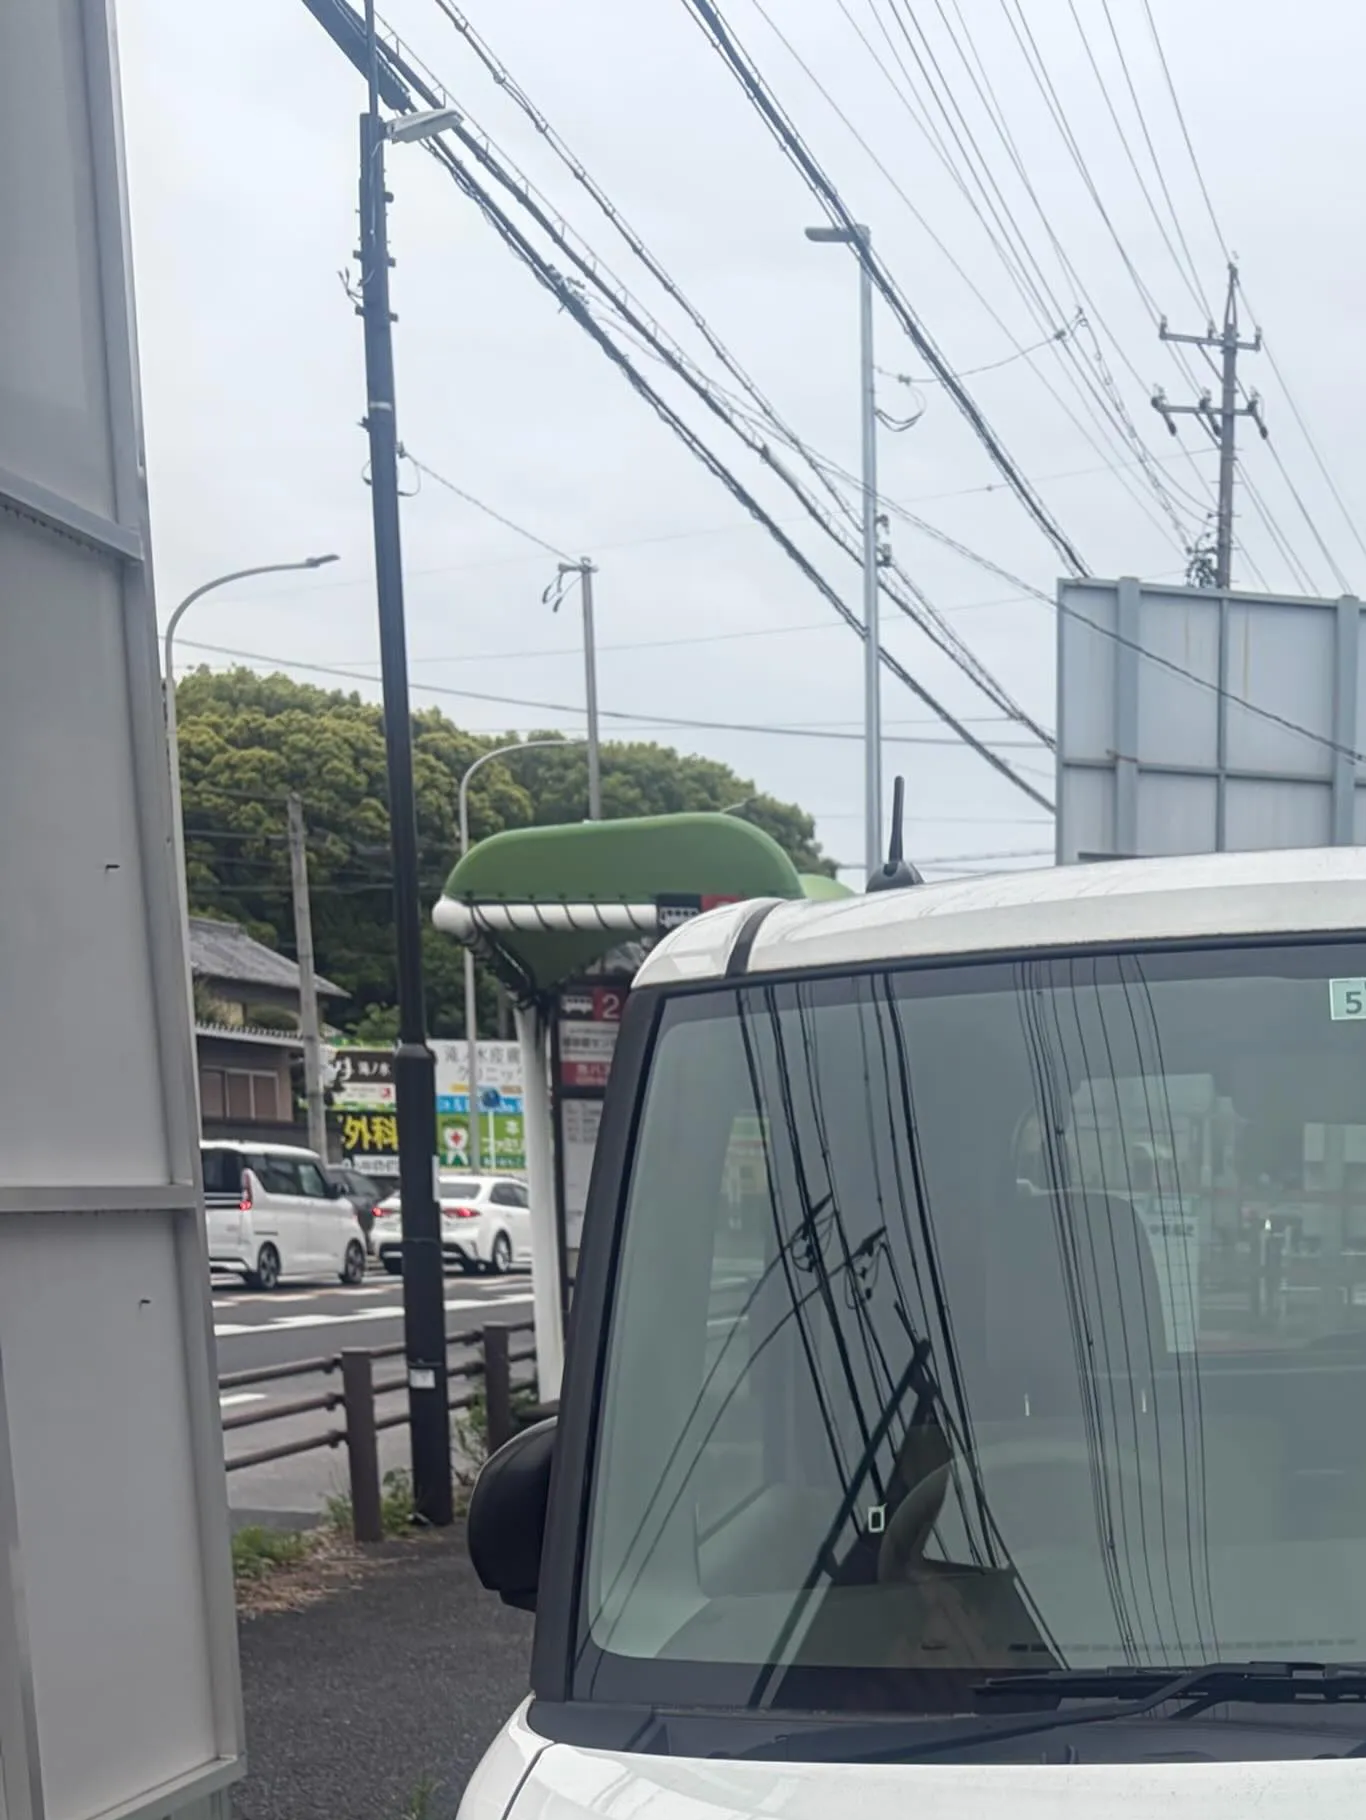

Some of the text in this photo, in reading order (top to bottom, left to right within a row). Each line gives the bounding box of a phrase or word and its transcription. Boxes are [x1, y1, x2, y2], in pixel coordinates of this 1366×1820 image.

[602, 994, 620, 1019] 2
[1345, 991, 1362, 1014] 5
[344, 1115, 398, 1151] 外科
